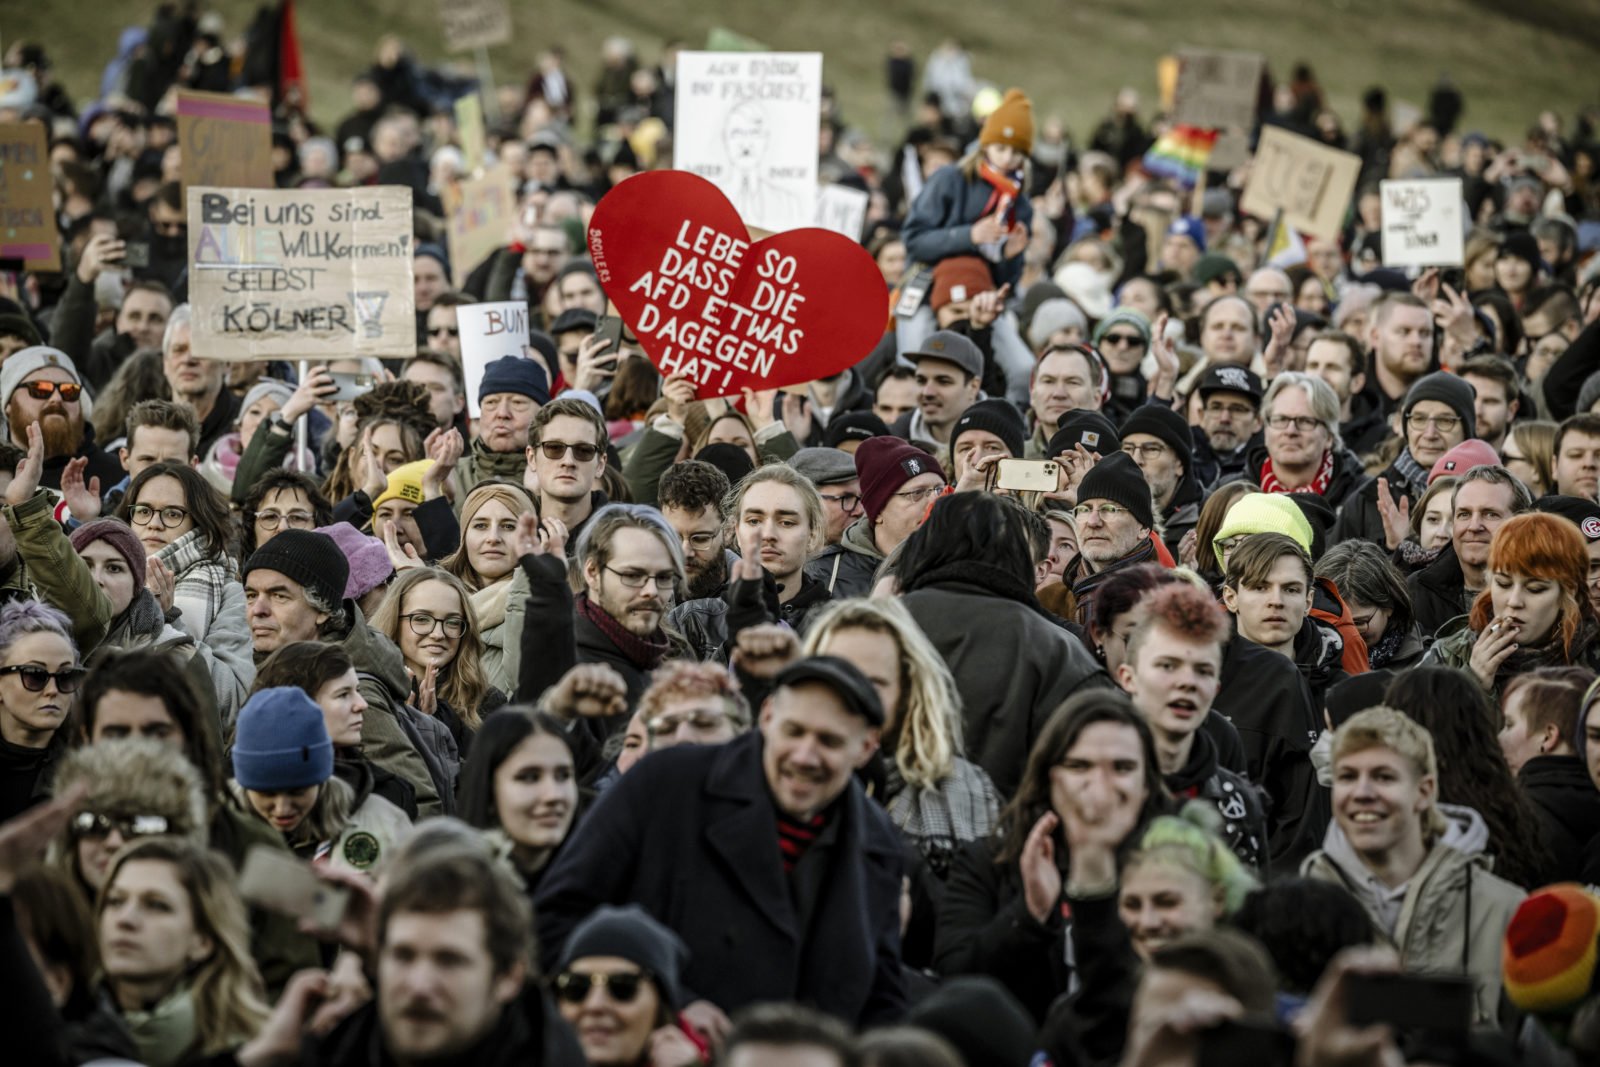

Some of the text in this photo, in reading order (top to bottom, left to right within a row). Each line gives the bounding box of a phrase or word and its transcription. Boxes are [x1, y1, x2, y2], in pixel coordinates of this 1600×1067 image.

[201, 193, 384, 226] Bei uns sind
[194, 226, 279, 263] ALLE
[590, 228, 611, 283] BROILERS
[676, 219, 800, 291] LEBE SO,
[222, 267, 327, 293] SELBST
[659, 247, 806, 324] DASS DIE
[629, 271, 804, 355] AFD ETWAS
[636, 303, 776, 378] DAGEGEN
